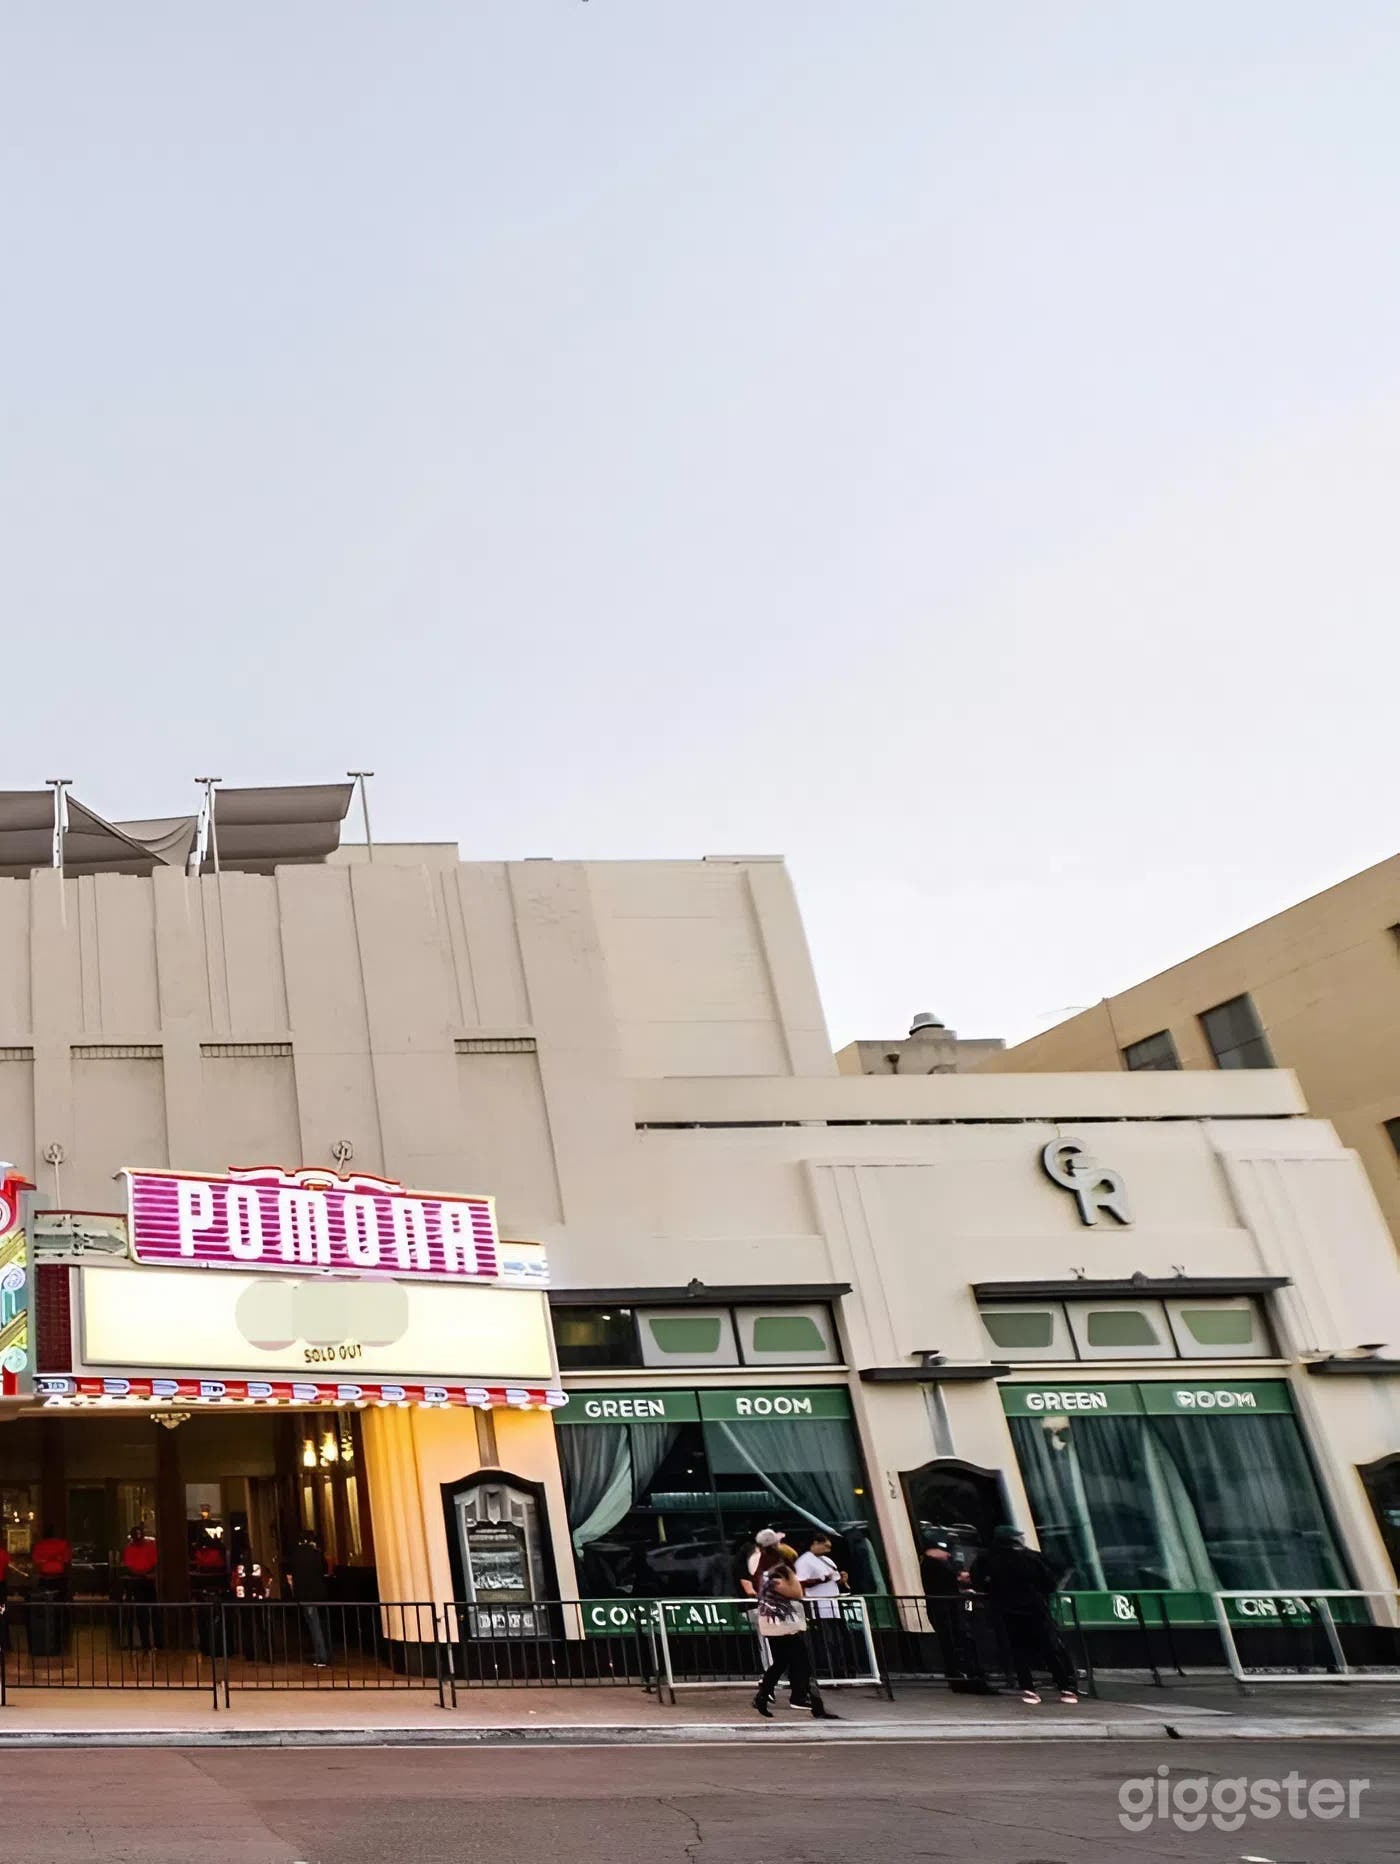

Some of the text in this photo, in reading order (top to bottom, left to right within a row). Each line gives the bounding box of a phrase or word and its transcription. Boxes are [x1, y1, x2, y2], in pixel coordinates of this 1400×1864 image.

[175, 1179, 479, 1275] POMONA
[304, 1344, 362, 1363] SOLD OUT
[584, 1397, 813, 1418] GREEN ROOM
[1026, 1391, 1108, 1410] GREEN
